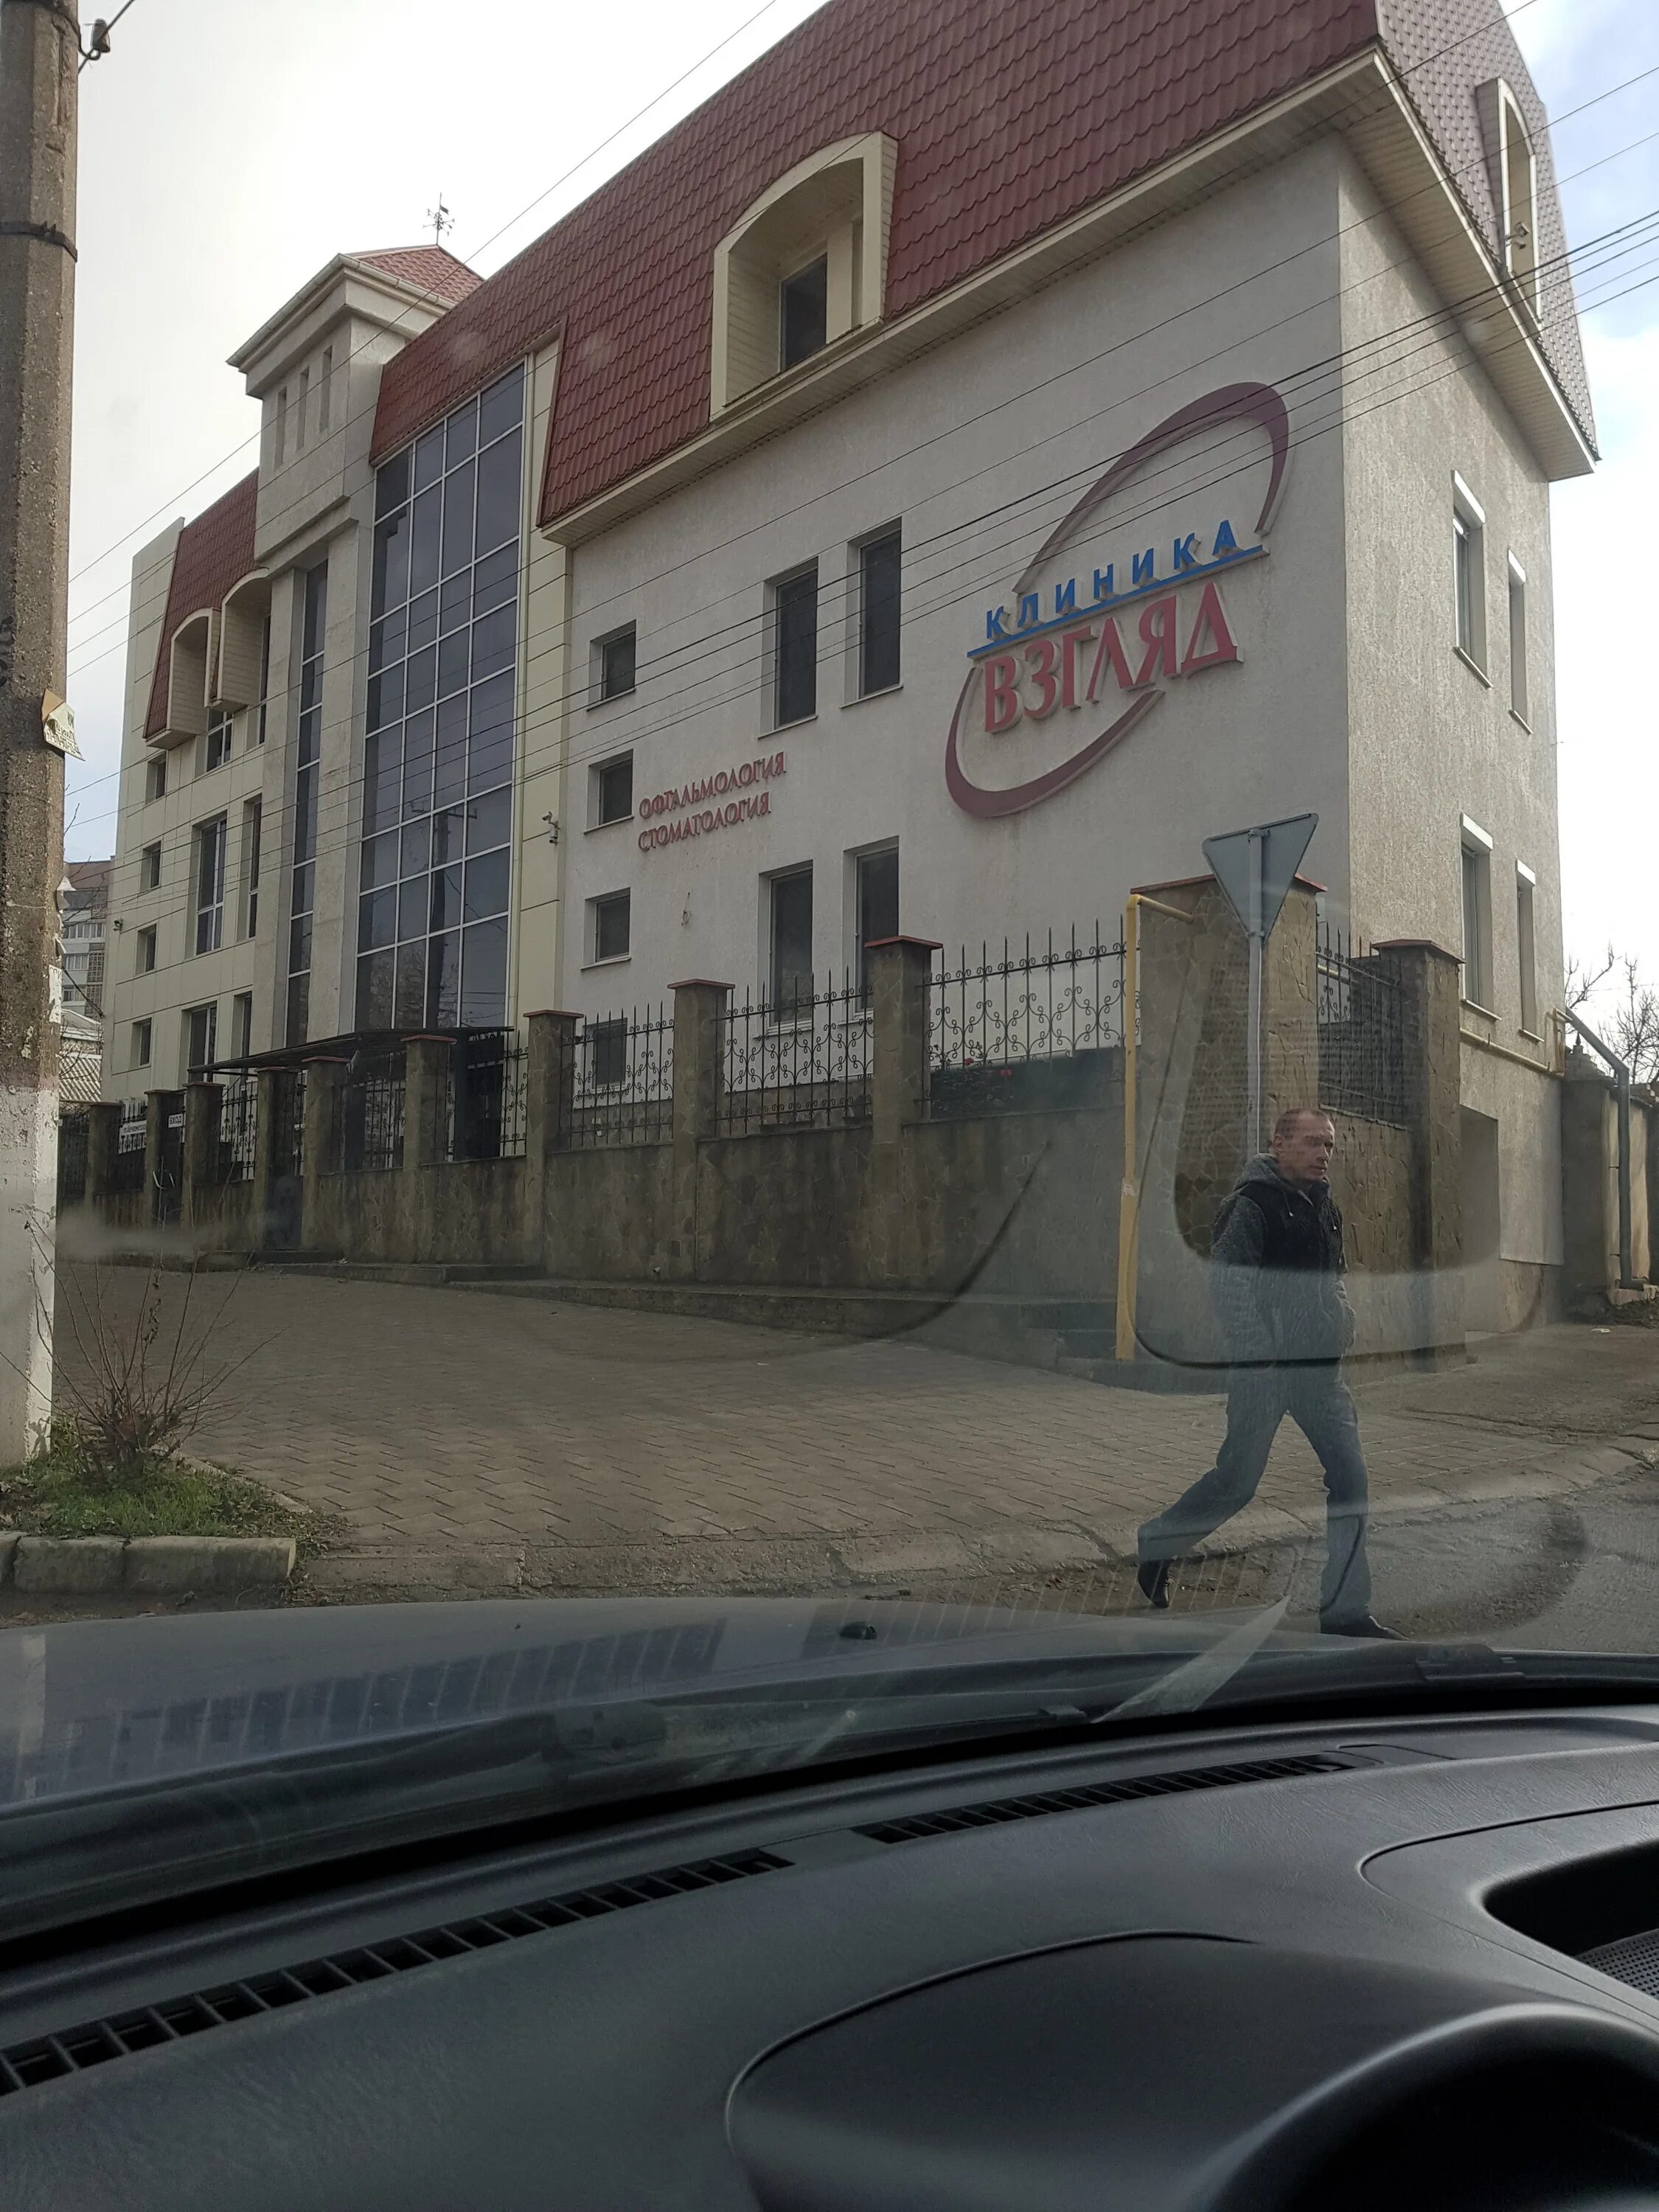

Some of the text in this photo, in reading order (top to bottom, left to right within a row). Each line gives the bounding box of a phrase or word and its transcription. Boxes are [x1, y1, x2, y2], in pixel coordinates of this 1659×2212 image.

[986, 519, 1242, 639] КЛИНИКА
[984, 582, 1242, 734] ВЗГЛЯД
[638, 791, 771, 852] СТОМАТОЛОГИЯ
[639, 751, 787, 820] ОФТАЛЬМОЛОГИЯ
